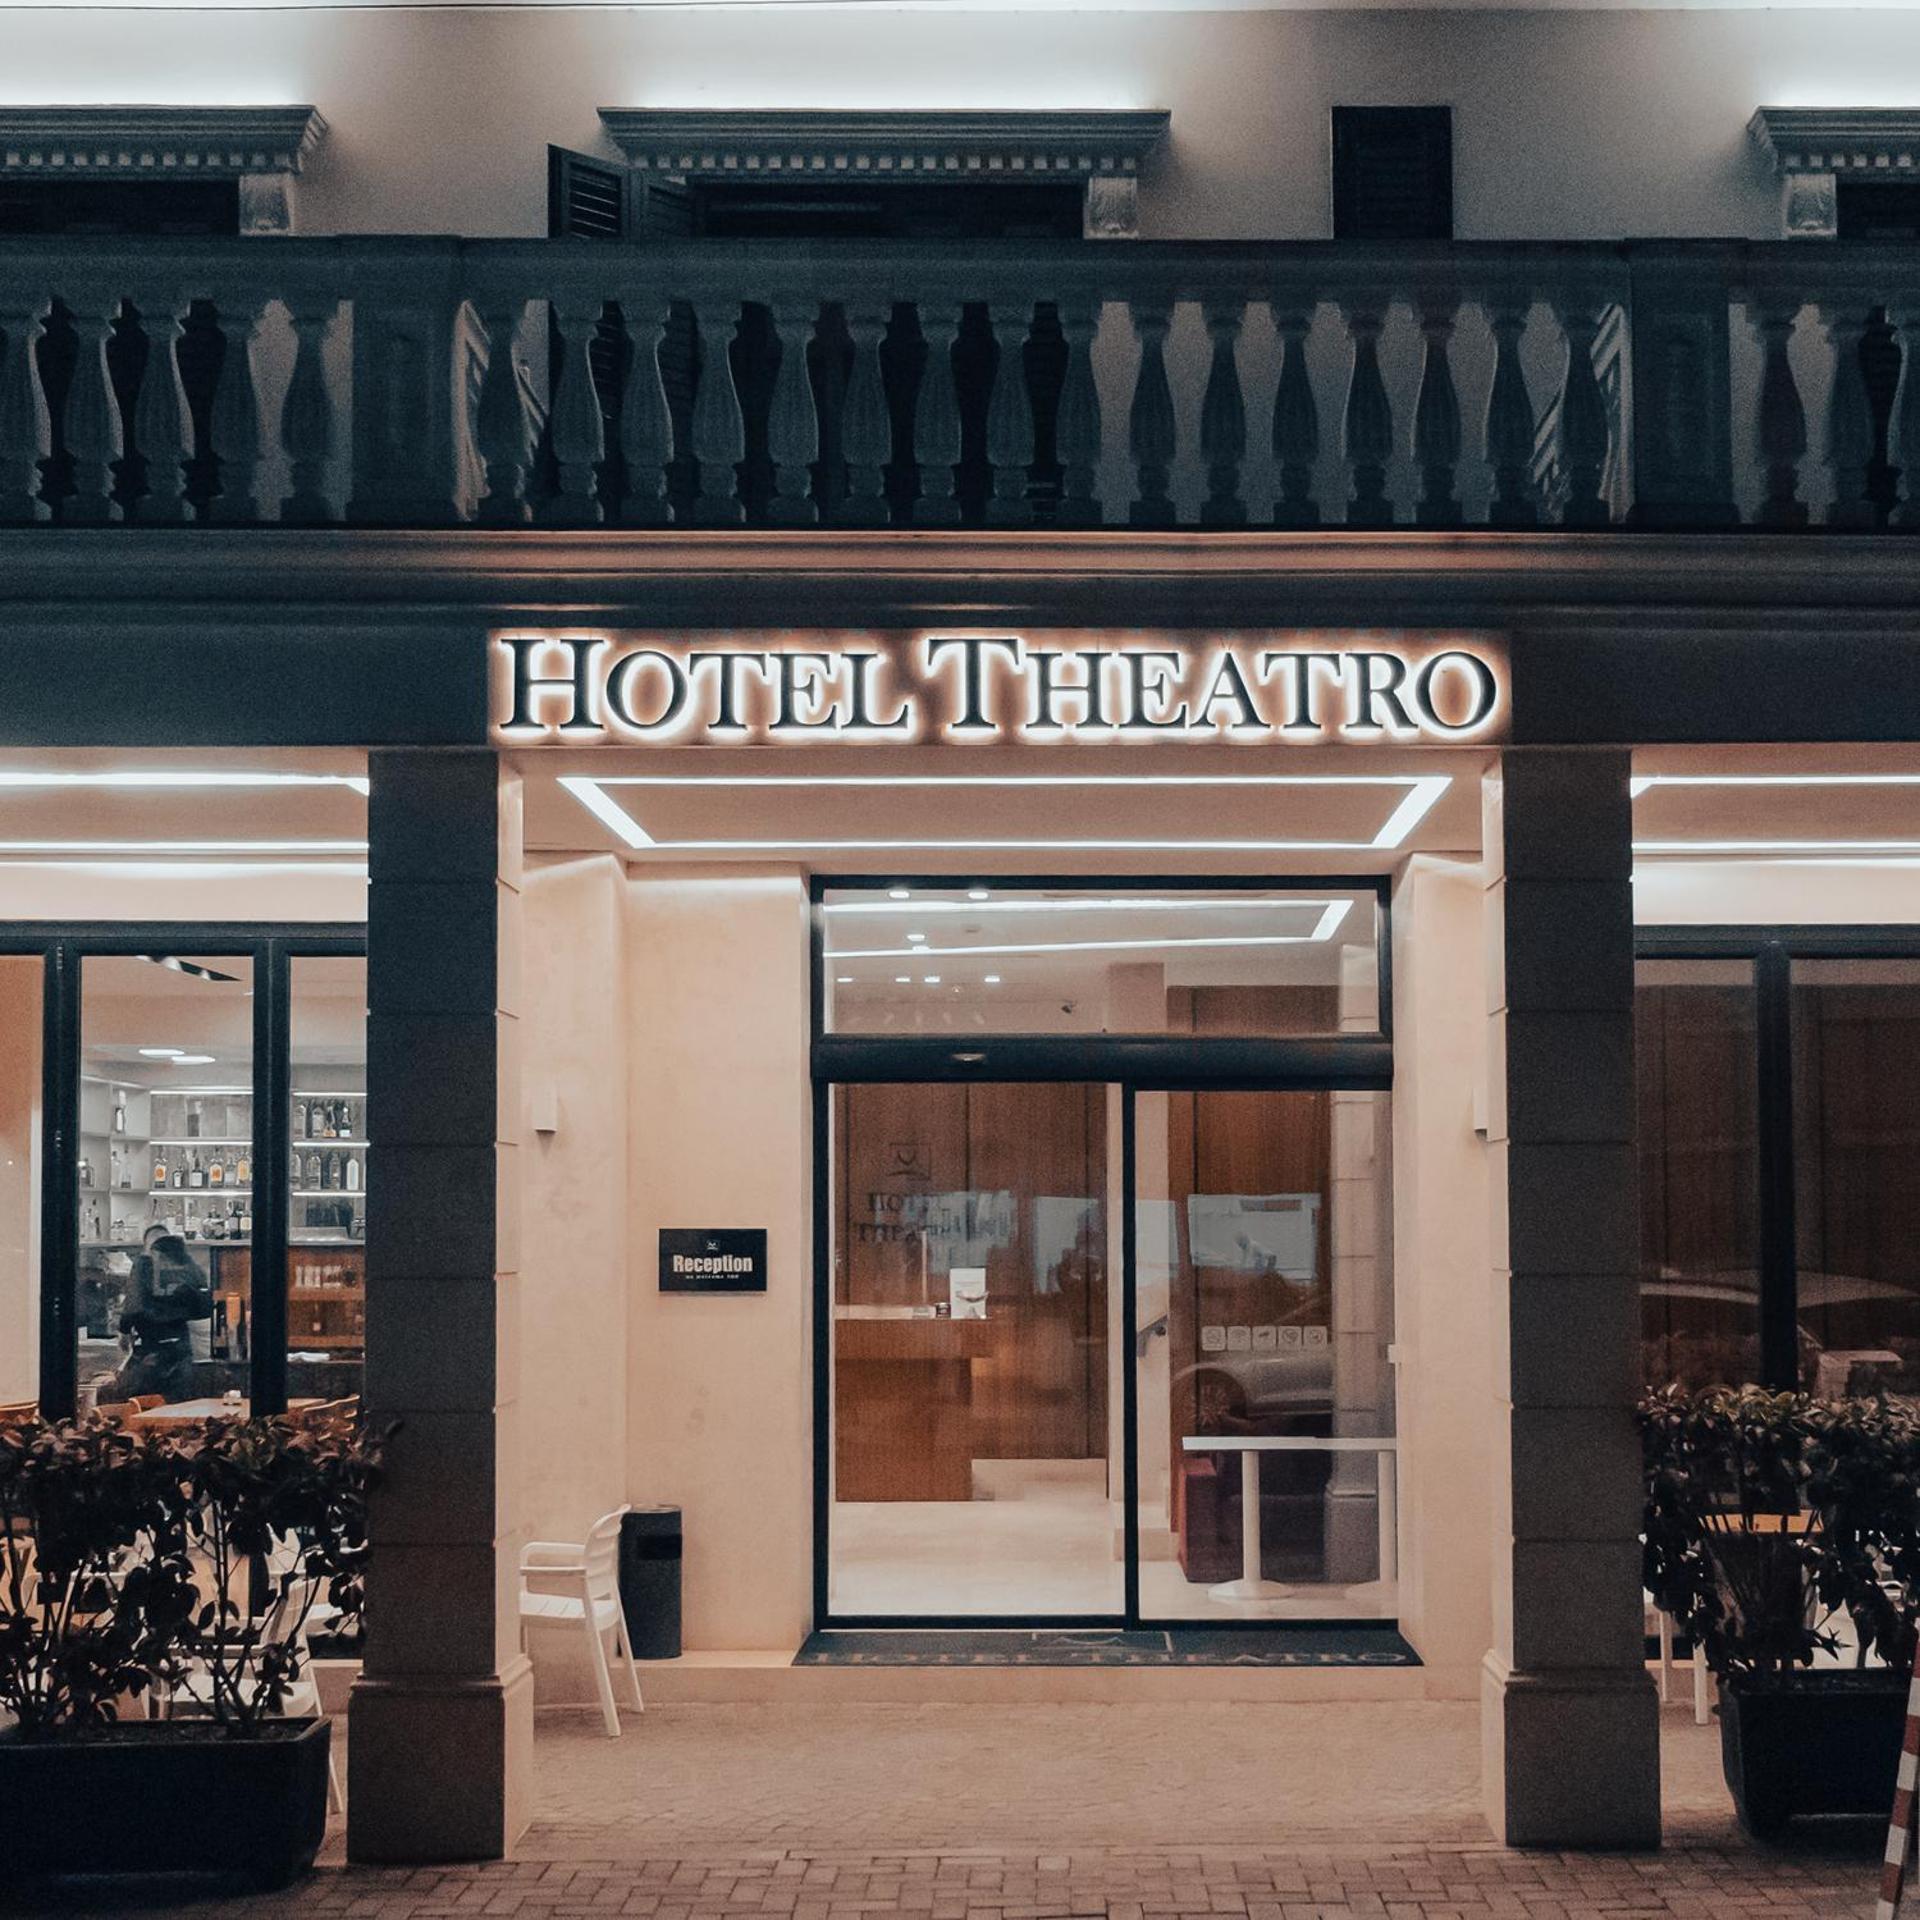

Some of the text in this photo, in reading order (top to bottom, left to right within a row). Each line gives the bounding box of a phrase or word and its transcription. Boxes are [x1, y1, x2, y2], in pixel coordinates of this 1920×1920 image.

[500, 637, 1497, 731] HOTEL THEATRO
[672, 1254, 753, 1274] Reception
